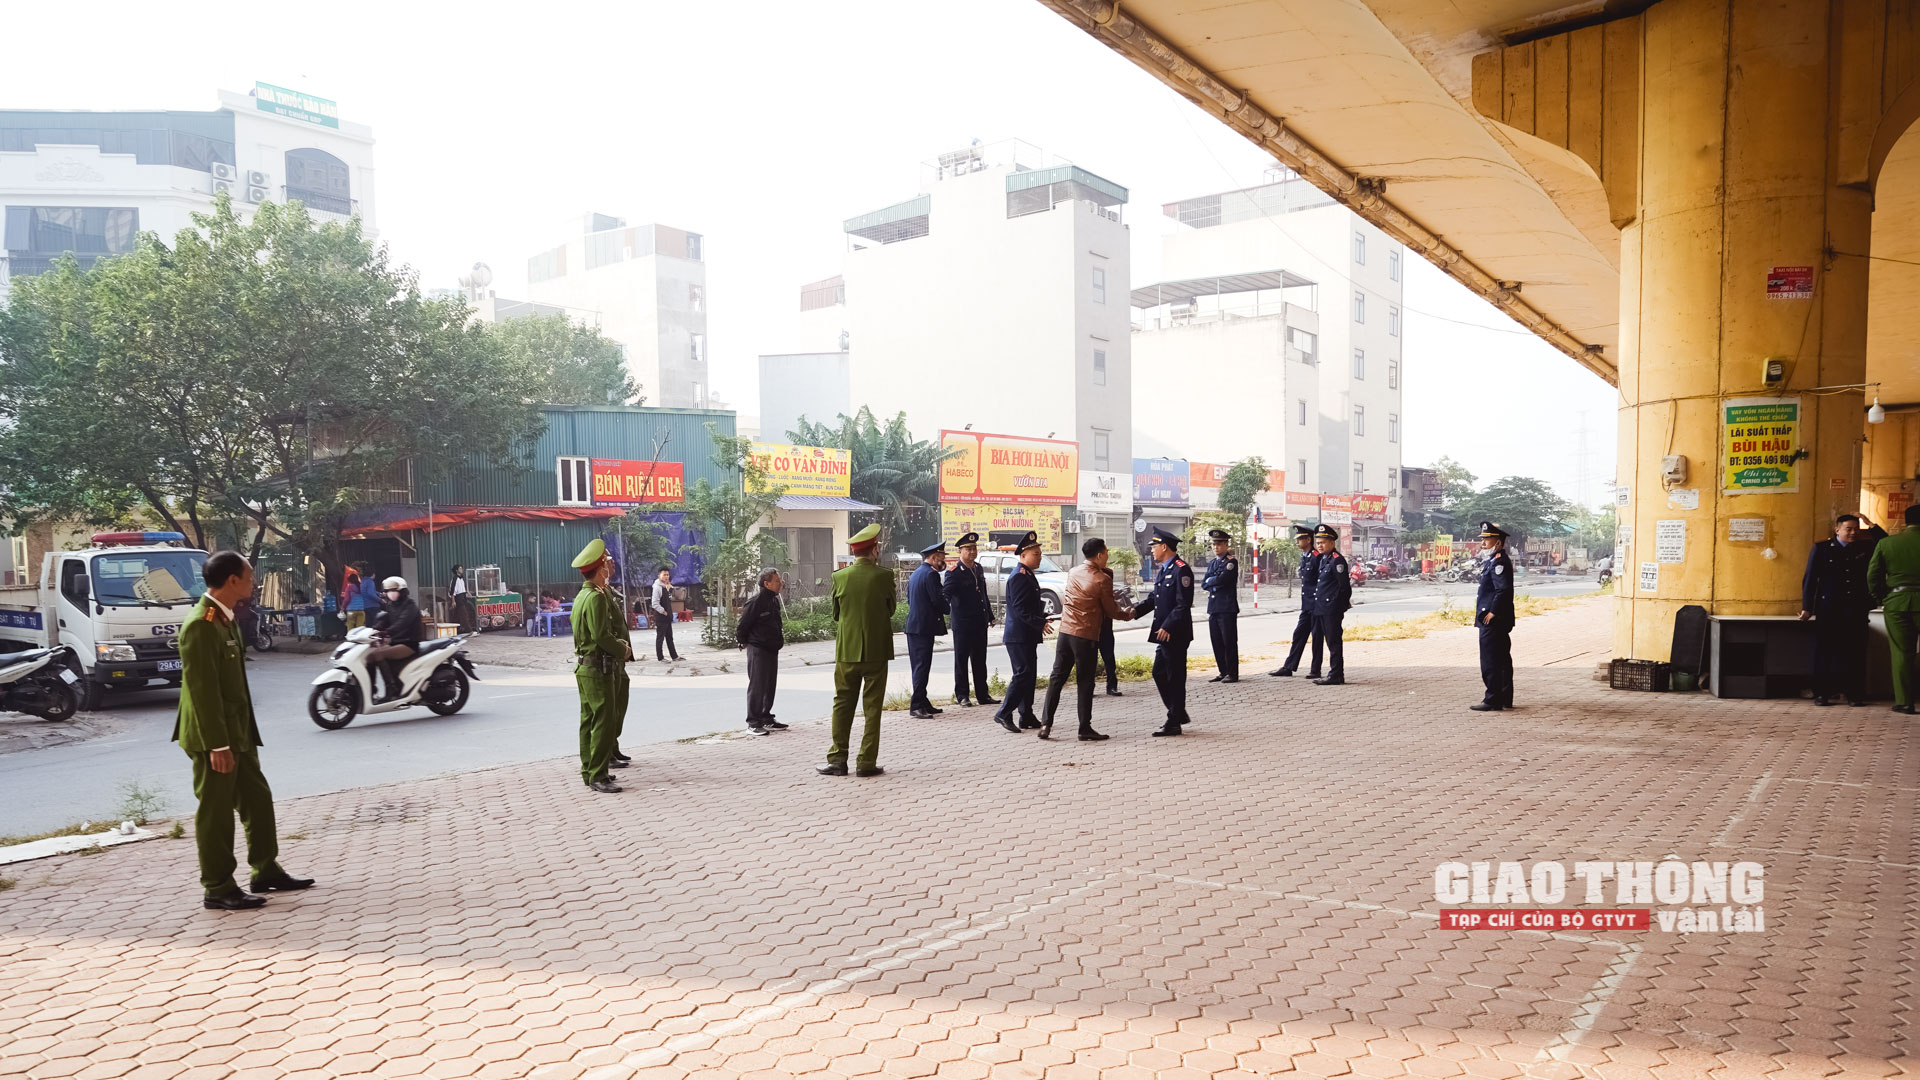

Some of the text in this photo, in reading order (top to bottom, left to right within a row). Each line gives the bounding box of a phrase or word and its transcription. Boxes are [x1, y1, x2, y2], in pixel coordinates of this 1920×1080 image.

[1744, 407, 1757, 415] VỐN
[1731, 424, 1792, 437] LÃI SUẤT THẤP
[1732, 437, 1790, 453] BÙI HẬU
[774, 451, 790, 472] CỎ
[793, 453, 818, 473] VÂN
[820, 456, 848, 476] ĐÌNH
[991, 449, 1069, 472] BIA HƠI HÀ NỘI
[1730, 456, 1741, 466] ĐT:
[1743, 455, 1762, 466] 0356
[946, 468, 974, 478] HABECO
[595, 470, 682, 498] BÚN RIÊU CUA
[1035, 477, 1048, 488] BIA
[1098, 475, 1116, 491] Nail
[1435, 543, 1450, 556] BÚN
[152, 624, 183, 636] CST
[160, 661, 183, 670] 29A-02
